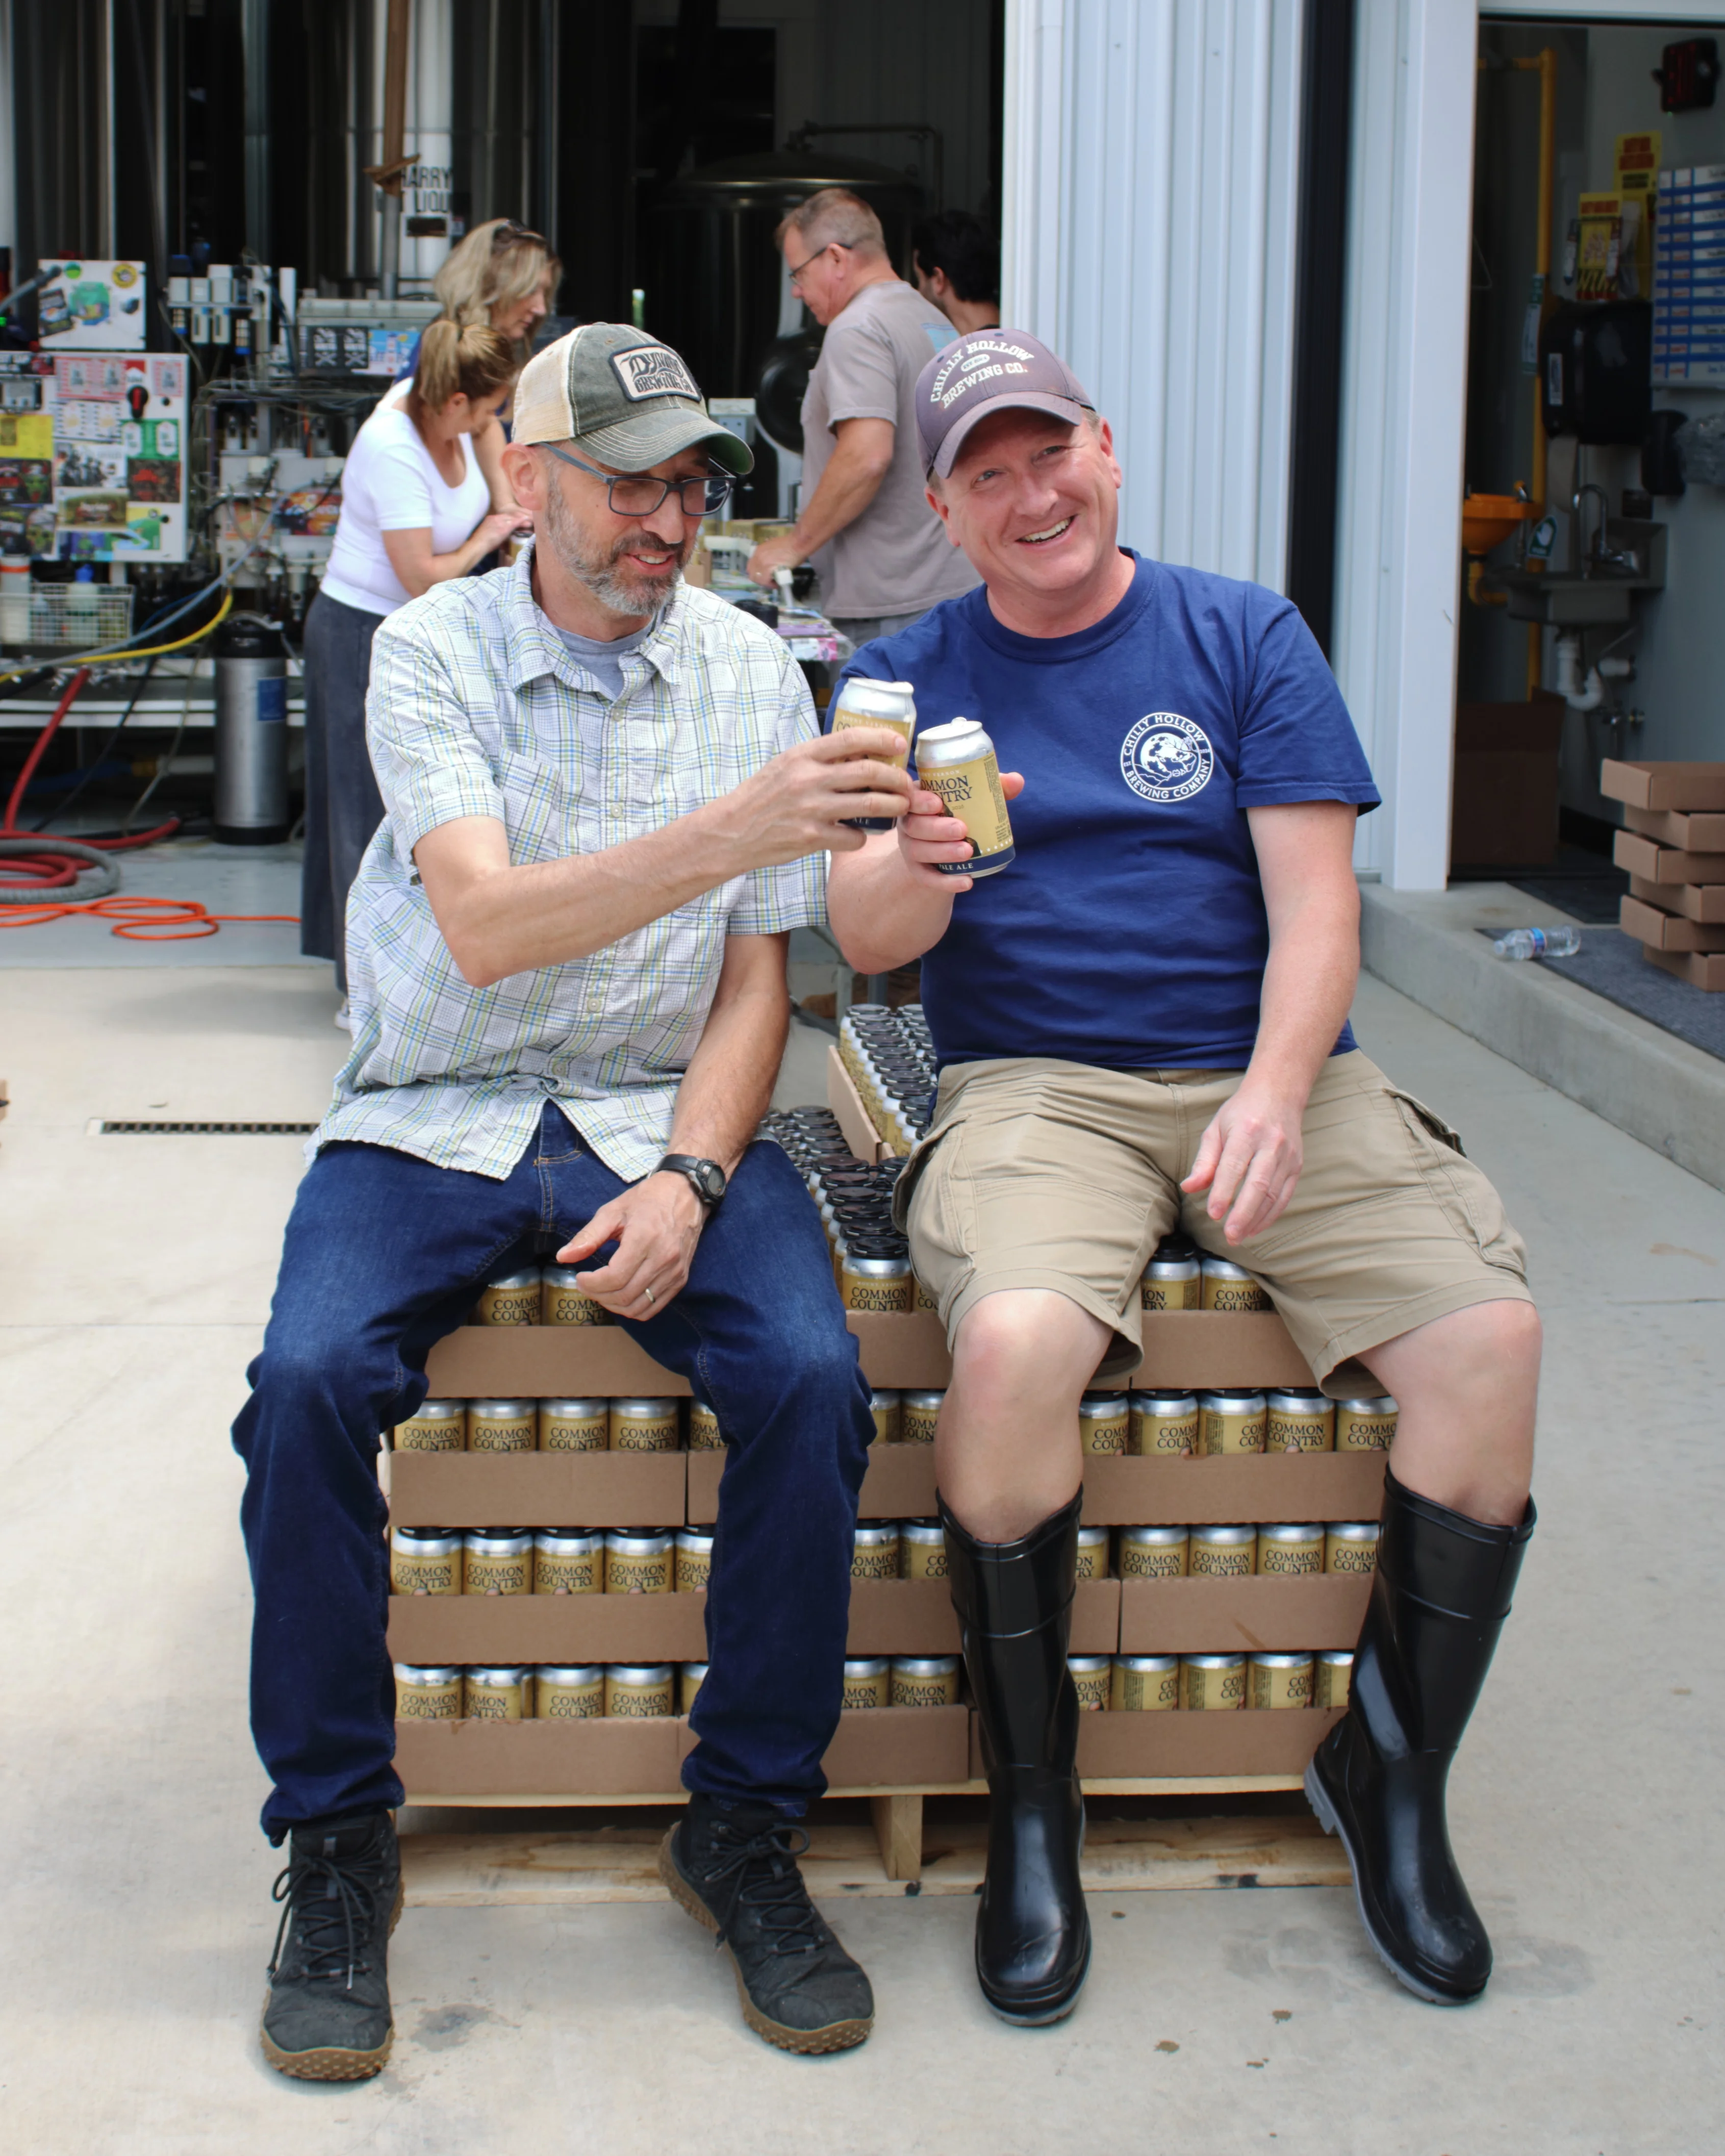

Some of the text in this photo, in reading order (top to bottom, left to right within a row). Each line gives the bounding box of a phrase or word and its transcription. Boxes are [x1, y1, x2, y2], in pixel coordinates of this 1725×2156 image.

[930, 341, 1034, 402] CHILLY HOLLOW
[941, 362, 1028, 409] BREWING CO.
[1124, 715, 1205, 756] CHILLY HOLLOW
[920, 775, 969, 791] OMMON
[1126, 758, 1210, 799] BREWING COMPANY
[934, 787, 973, 803] NTRY
[851, 1286, 908, 1300] COMMON
[1216, 1289, 1264, 1302] COMMO
[493, 1295, 541, 1310] COMMO
[557, 1299, 602, 1310] COMM
[850, 1297, 907, 1311] COUNTRY
[1214, 1301, 1263, 1311] COUNT
[491, 1306, 540, 1322] COUNT
[555, 1309, 605, 1321] COUNT
[904, 1415, 937, 1429] COMM
[1269, 1420, 1324, 1435] COMMON
[1350, 1423, 1397, 1436] COMMO
[475, 1426, 532, 1440] COMMON
[550, 1424, 605, 1440] COMMON
[903, 1426, 935, 1441] COUN
[1268, 1431, 1326, 1447] COUNTRY
[1348, 1434, 1396, 1447] COUNT
[853, 1554, 896, 1567] OMMO
[1125, 1551, 1181, 1565] COMMON
[1194, 1551, 1250, 1566] COMMON
[1266, 1549, 1321, 1563] COMMON
[1335, 1549, 1376, 1562] COMM
[396, 1563, 452, 1578] COMMON
[468, 1563, 524, 1578] COMMON
[537, 1562, 593, 1577] COMMON
[610, 1562, 666, 1577] COMMON
[677, 1559, 711, 1575] COMM
[1124, 1561, 1182, 1577] COUNTRY
[1193, 1561, 1250, 1577] COUNTRY
[1264, 1560, 1321, 1575] COUNTRY
[1334, 1559, 1376, 1573] COUNT
[395, 1573, 453, 1588] COUNTRY
[467, 1574, 526, 1589] COUNTRY
[536, 1572, 594, 1588] COUNTRY
[608, 1572, 667, 1588] COUNTRY
[677, 1571, 709, 1585] COUN
[402, 1693, 458, 1707] COMMON
[613, 1691, 669, 1707] COMMON
[843, 1695, 878, 1709] NTRY
[549, 1704, 602, 1718] COUNTR
